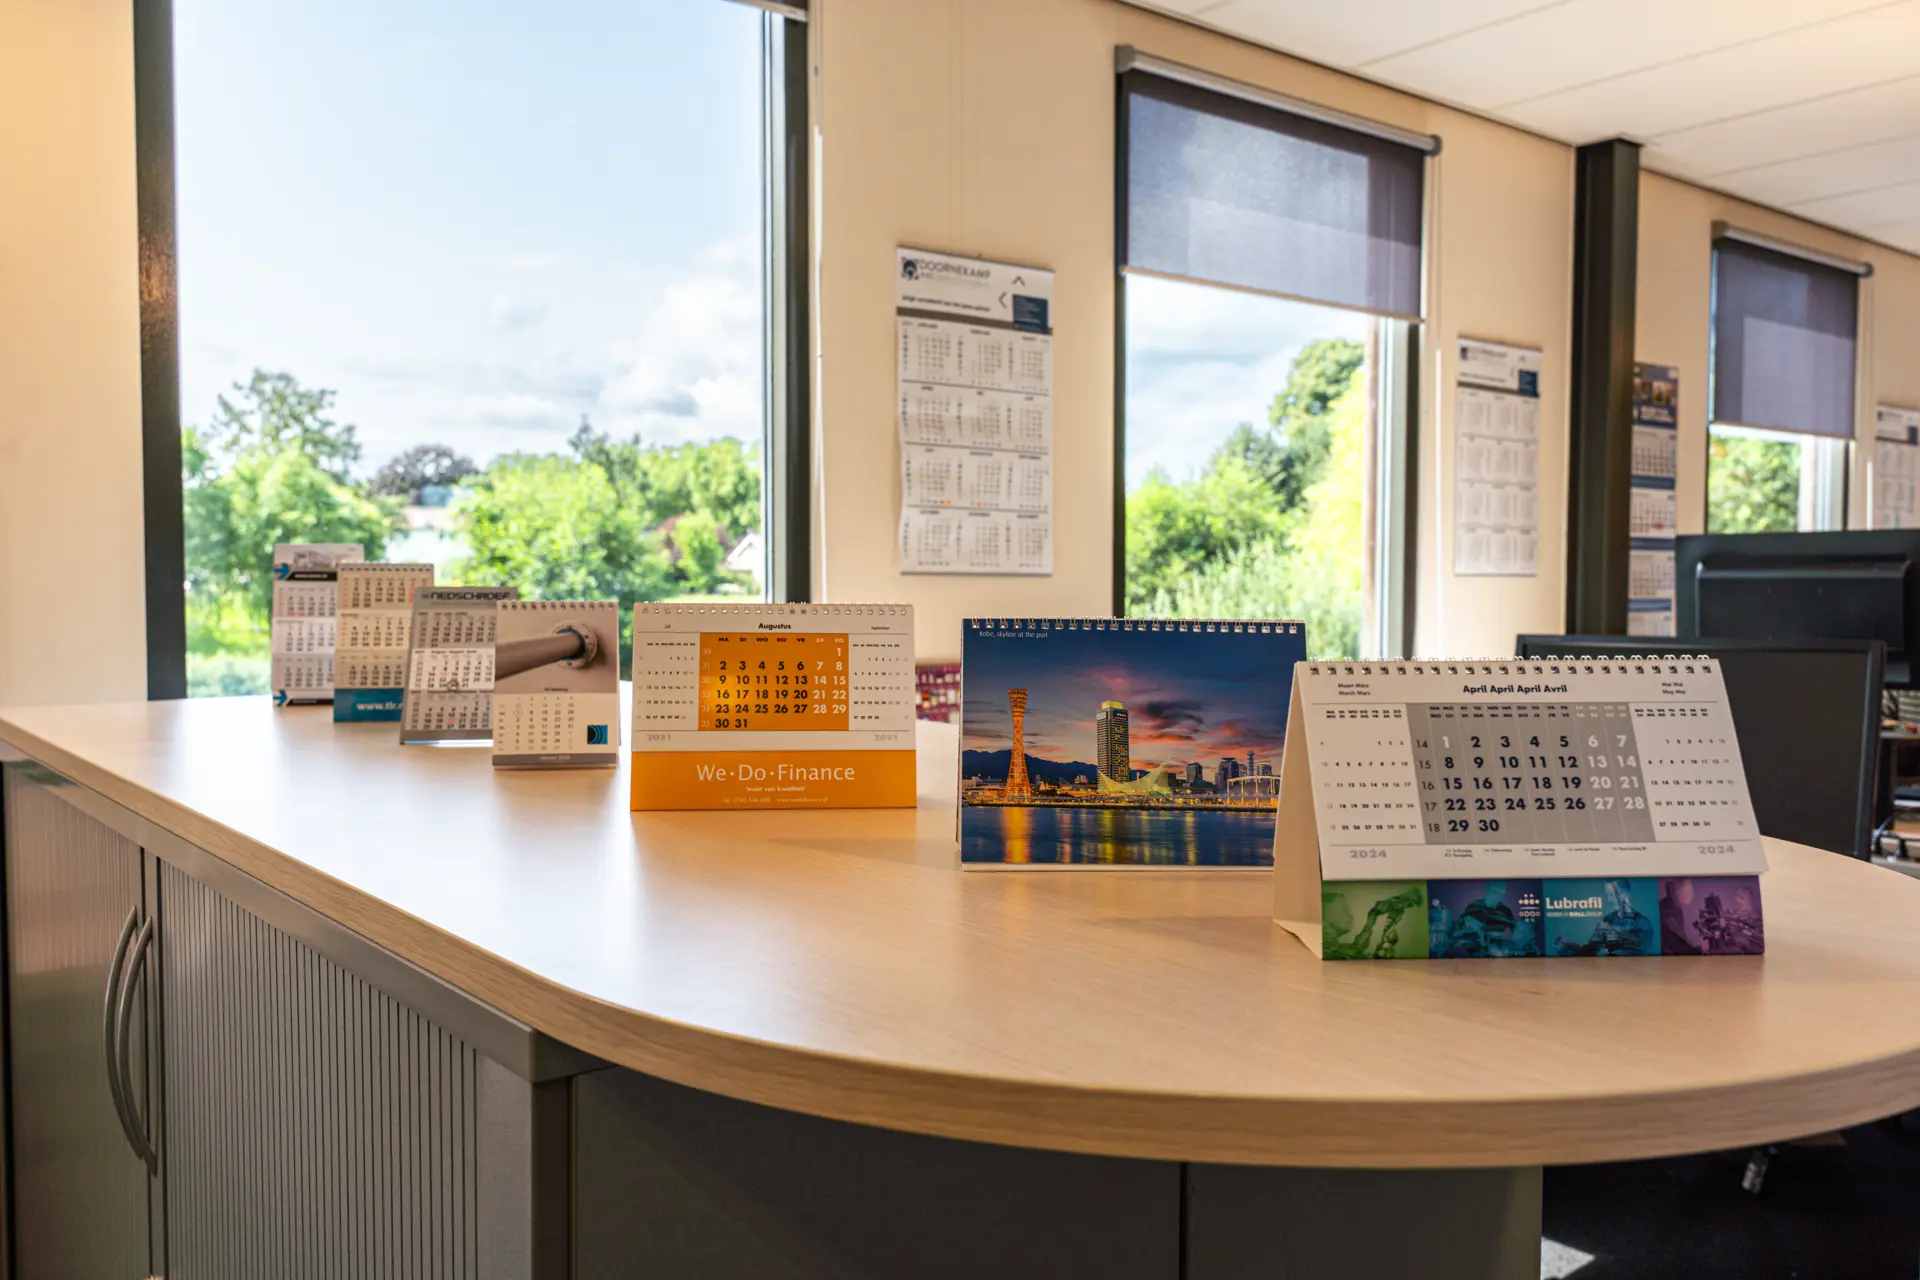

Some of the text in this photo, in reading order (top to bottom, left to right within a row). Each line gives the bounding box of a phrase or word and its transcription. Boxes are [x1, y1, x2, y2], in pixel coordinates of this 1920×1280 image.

[758, 622, 791, 631] Augustus
[837, 648, 841, 656] 1
[720, 661, 727, 670] 2
[739, 661, 746, 670] 3
[758, 661, 766, 670] 4
[778, 661, 784, 670] 5
[797, 662, 804, 670] 6
[817, 662, 823, 670] 7
[836, 662, 842, 670] 8
[719, 675, 726, 684] 9
[737, 675, 750, 684] 10
[756, 675, 767, 684] 11
[776, 675, 788, 684] 12
[795, 676, 808, 685] 13
[814, 676, 827, 685] 14
[833, 676, 846, 685] 15
[717, 690, 730, 699] 16
[736, 690, 749, 698] 17
[756, 690, 768, 699] 18
[776, 690, 788, 699] 19
[794, 690, 808, 699] 20
[813, 690, 825, 699] 21
[832, 690, 846, 699] 22
[1463, 685, 1568, 694] April April April Avril
[716, 704, 730, 713] 23
[735, 704, 749, 713] 24
[755, 704, 768, 713] 25
[774, 704, 788, 713] 26
[794, 704, 808, 713] 27
[813, 704, 827, 714] 28
[832, 704, 846, 714] 29
[715, 719, 730, 728] 30
[735, 719, 747, 728] 31
[1416, 735, 1627, 748] 14 1 2 3 4 5 6 7
[1419, 756, 1637, 769] 15 8 9 10 11 12 13 14
[778, 764, 855, 781] Finance
[1422, 776, 1639, 790] 16 15 16 17 18 19 20 21
[1425, 797, 1644, 811] 17 22 23 24 25 26 27 28
[1428, 820, 1499, 832] 18 29 30
[1350, 850, 1387, 858] 2024
[1698, 845, 1735, 854] 2024
[1545, 896, 1602, 908] Lubrafil
